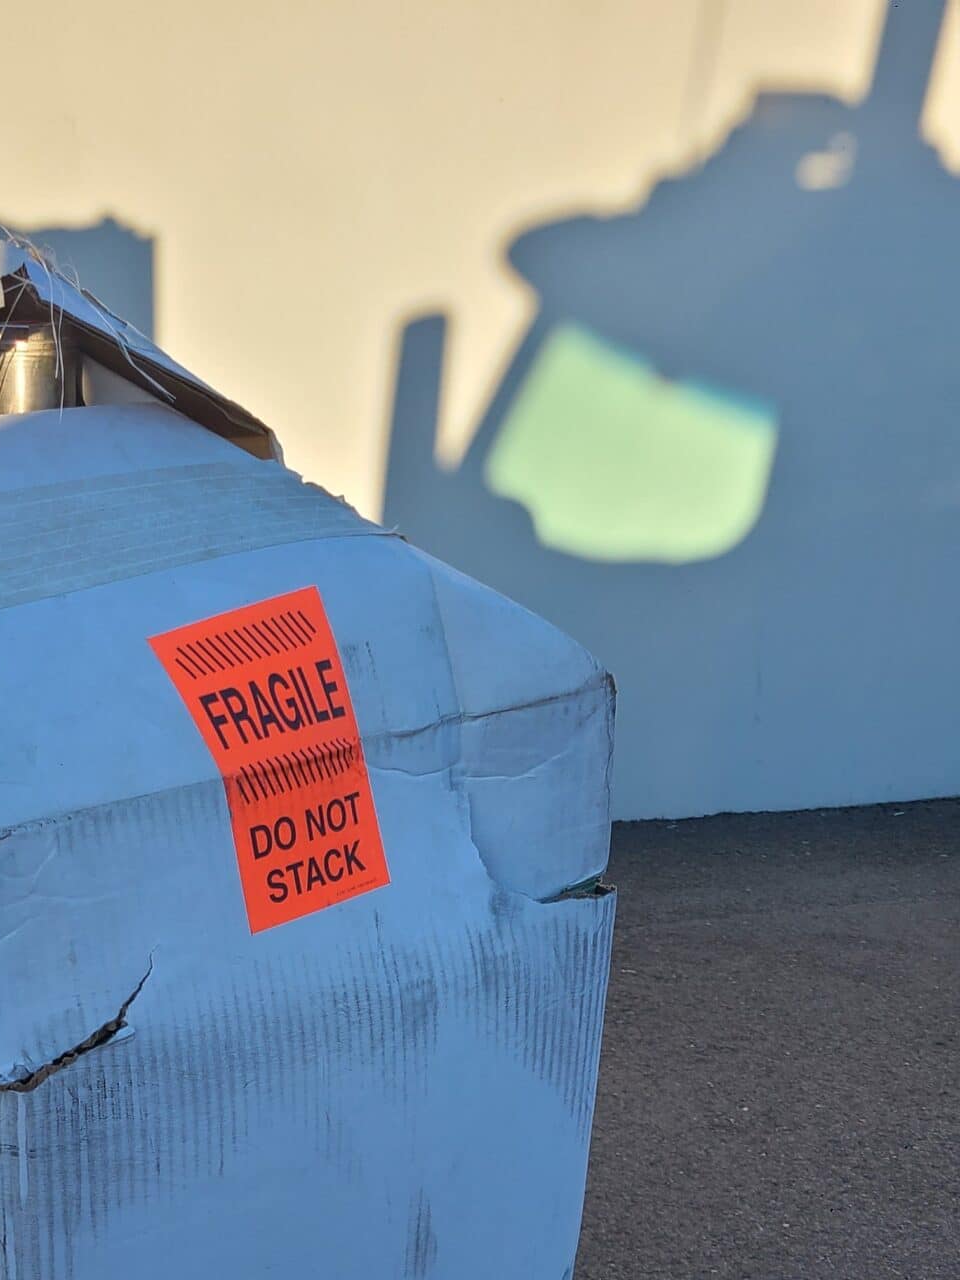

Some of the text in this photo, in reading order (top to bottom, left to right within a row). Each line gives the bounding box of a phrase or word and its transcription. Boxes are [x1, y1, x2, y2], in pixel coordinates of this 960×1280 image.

[198, 659, 346, 750] FRAGILE
[249, 792, 361, 860] DO NOT
[266, 840, 367, 903] STACK
